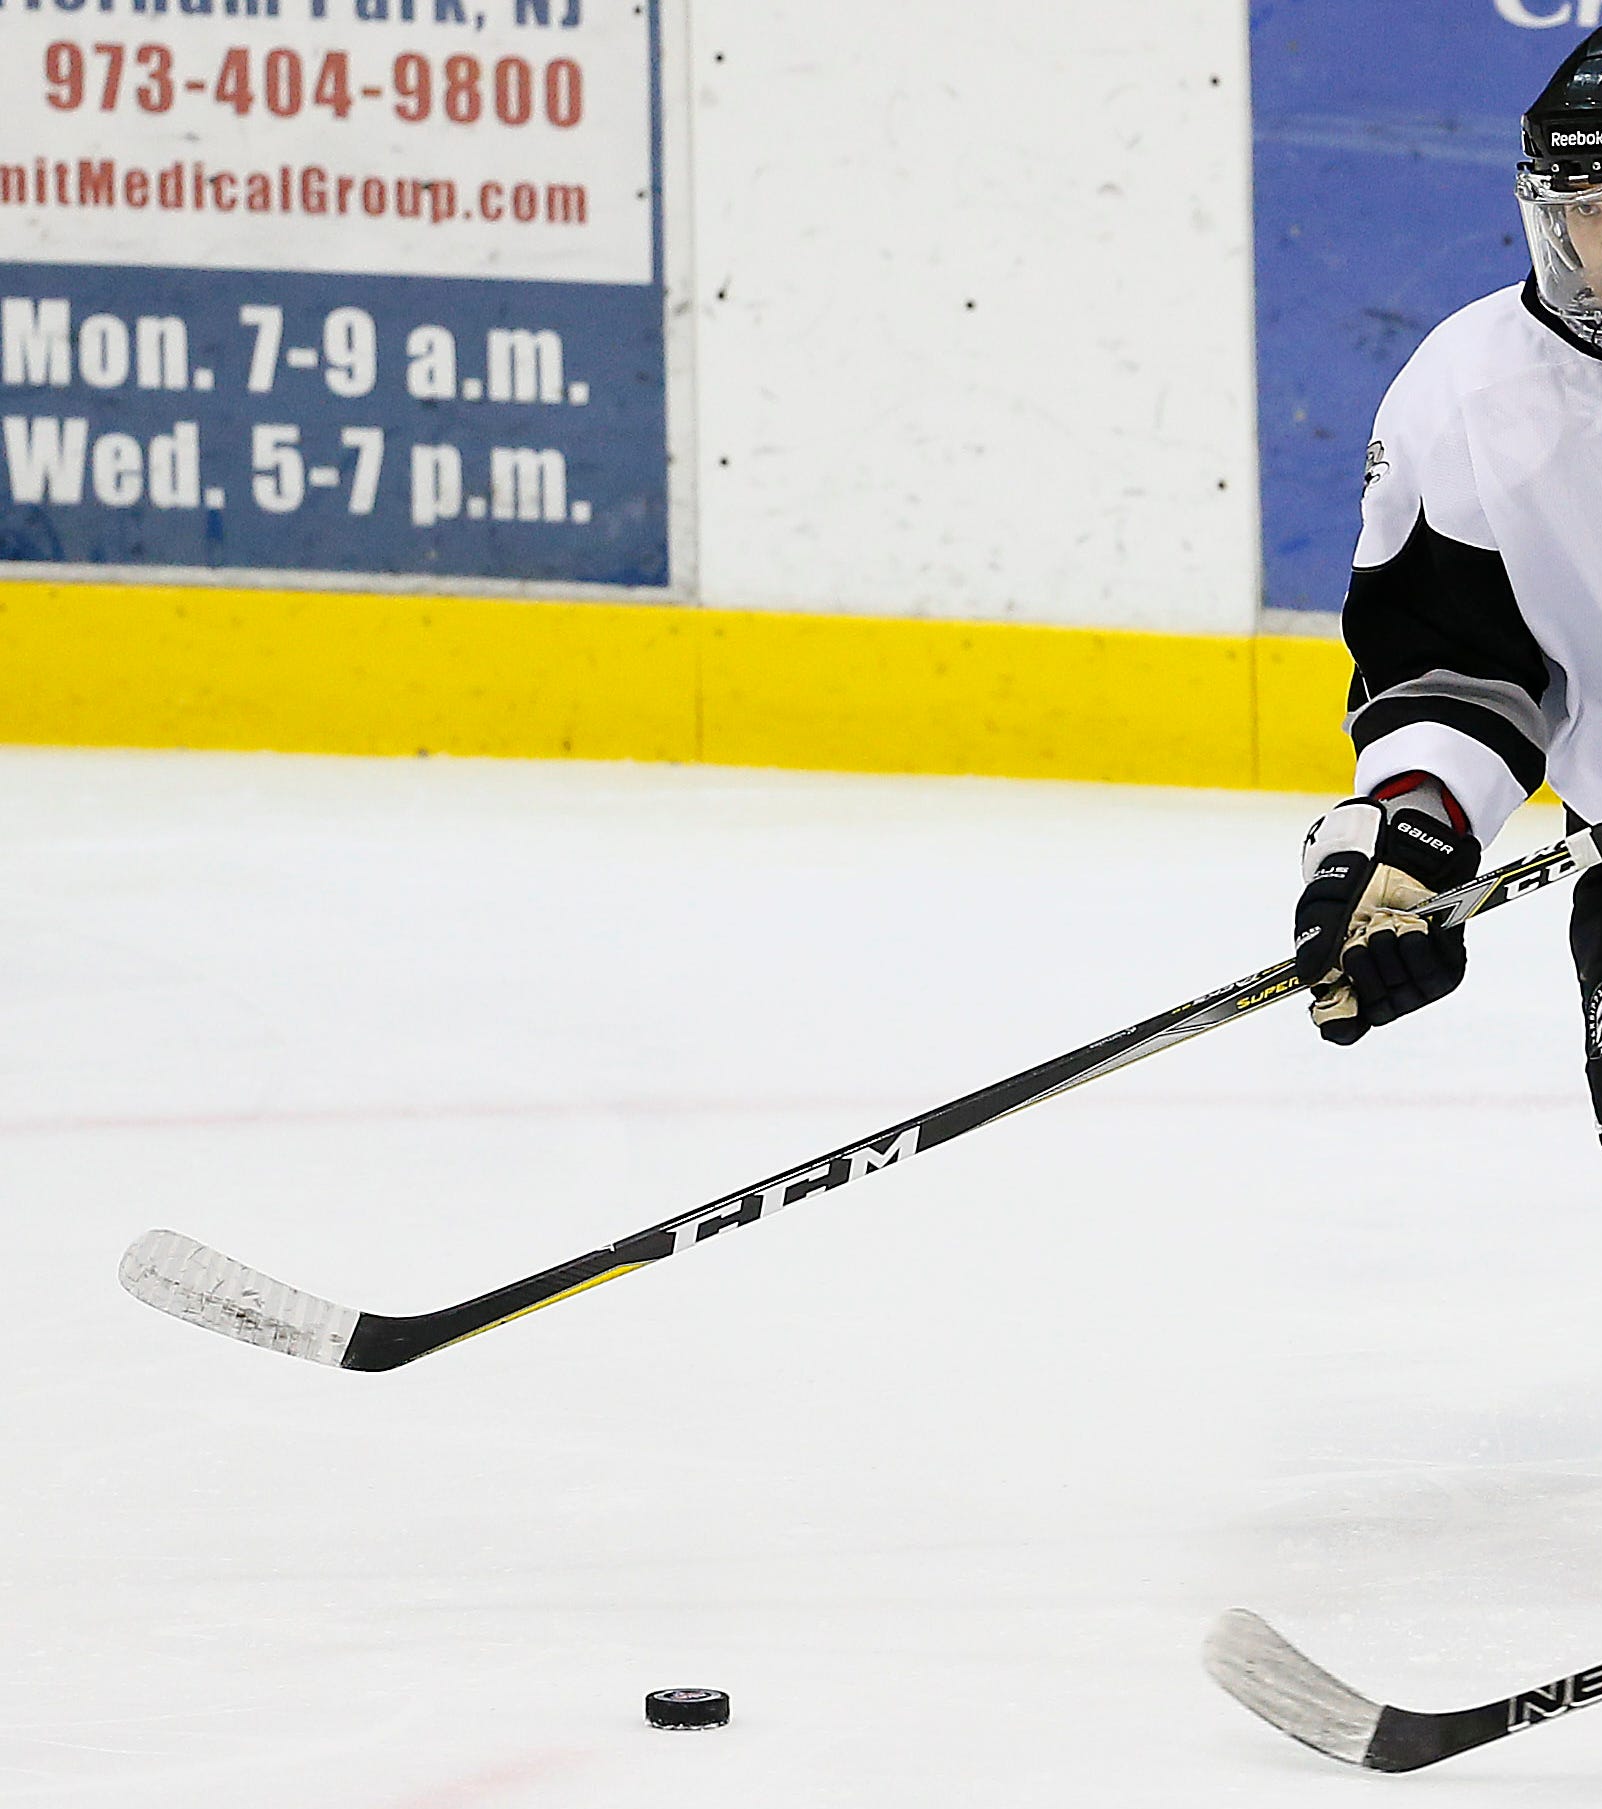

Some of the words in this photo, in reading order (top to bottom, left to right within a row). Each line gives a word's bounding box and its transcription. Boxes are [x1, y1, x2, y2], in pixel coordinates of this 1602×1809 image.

[45, 41, 584, 128] 973-404-9800
[1, 298, 214, 391] Mon.
[239, 305, 378, 398] 7-9
[406, 324, 590, 405] a.m.
[4, 416, 226, 509] Wed.
[251, 424, 385, 515] 5-7
[410, 444, 592, 526] p.m.
[672, 1125, 922, 1254] CCM
